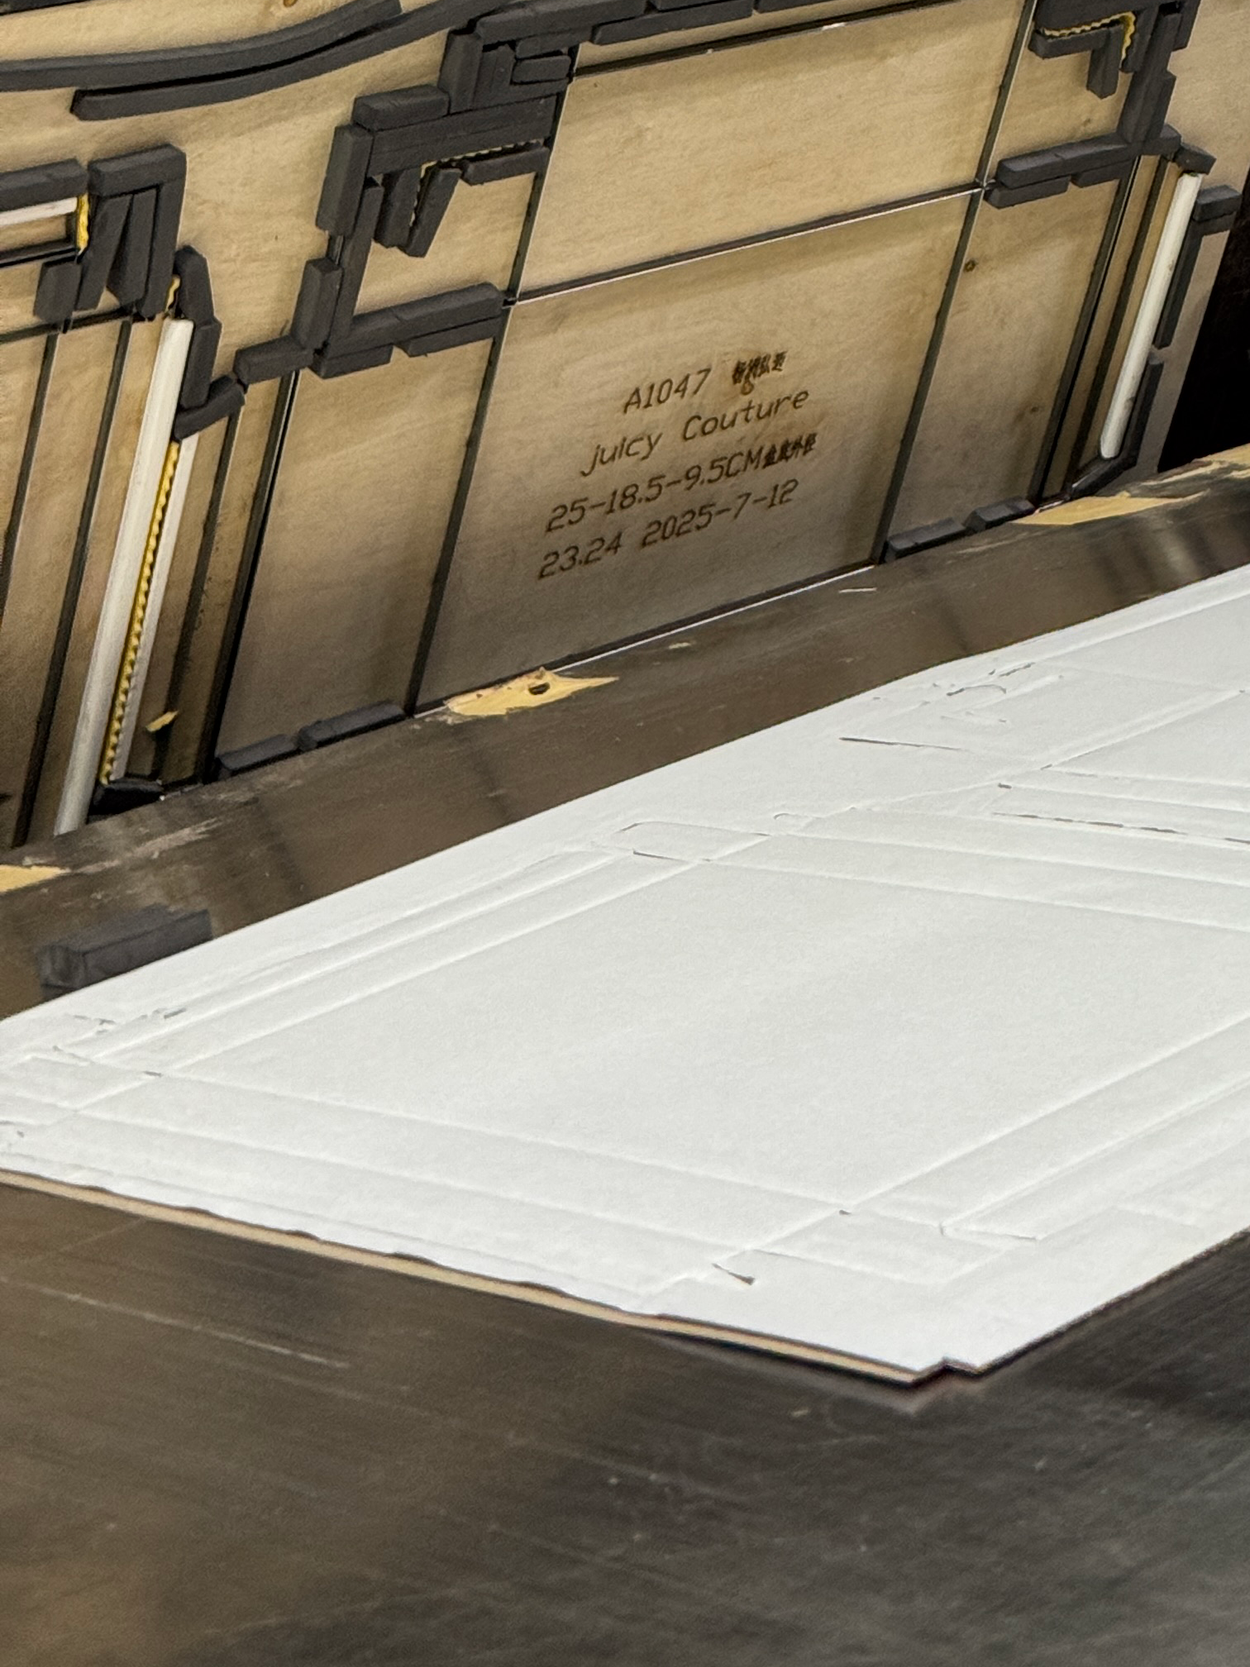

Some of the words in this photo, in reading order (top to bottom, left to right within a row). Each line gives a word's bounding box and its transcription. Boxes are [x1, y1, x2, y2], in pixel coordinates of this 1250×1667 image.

[623, 367, 713, 414] A1047
[682, 389, 810, 441] Couture
[537, 531, 624, 581] 23.24
[640, 478, 799, 549] 2025-7-12
